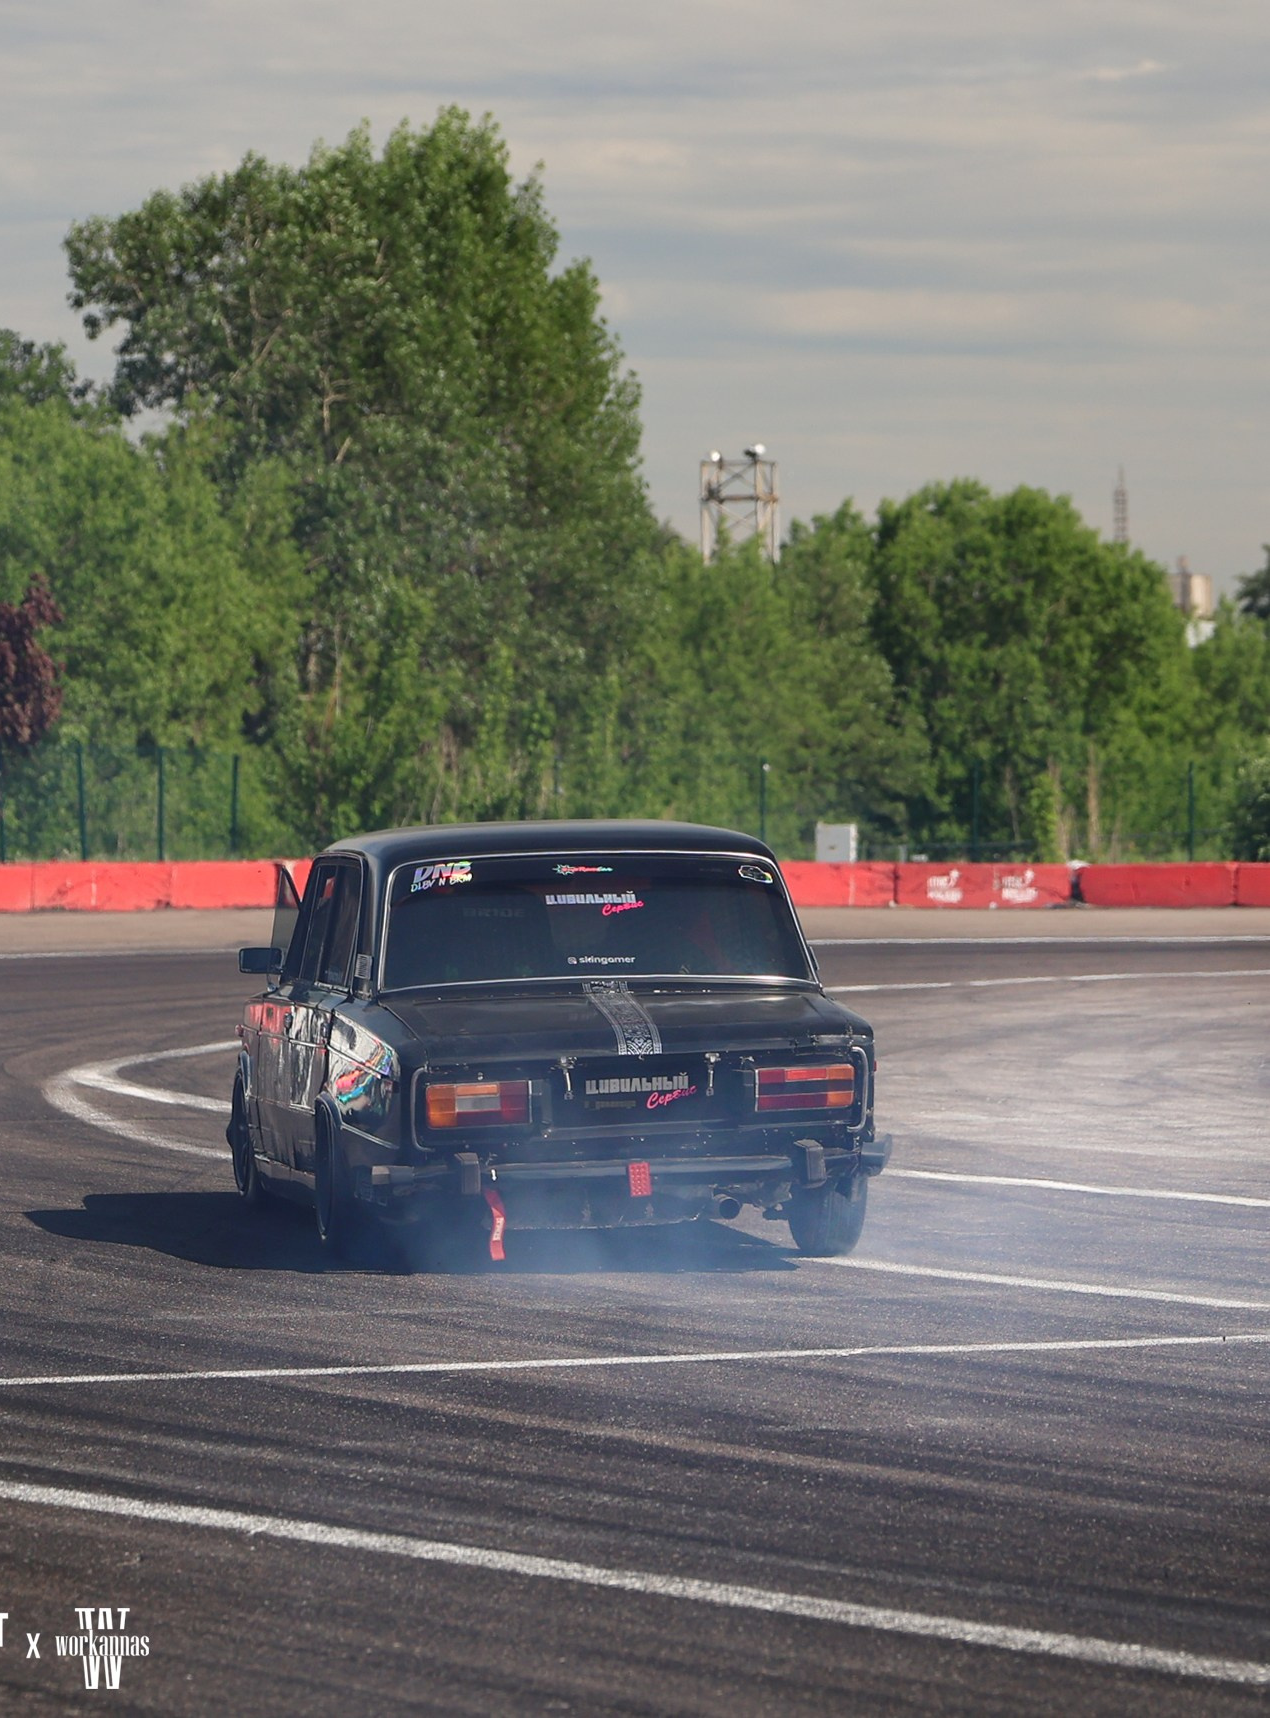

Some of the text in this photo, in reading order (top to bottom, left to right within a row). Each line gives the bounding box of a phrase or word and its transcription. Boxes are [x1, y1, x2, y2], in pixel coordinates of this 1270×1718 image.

[413, 861, 473, 883] DNB
[438, 878, 447, 886] N
[602, 901, 644, 916] Сервис
[646, 1085, 697, 1109] Сервис
